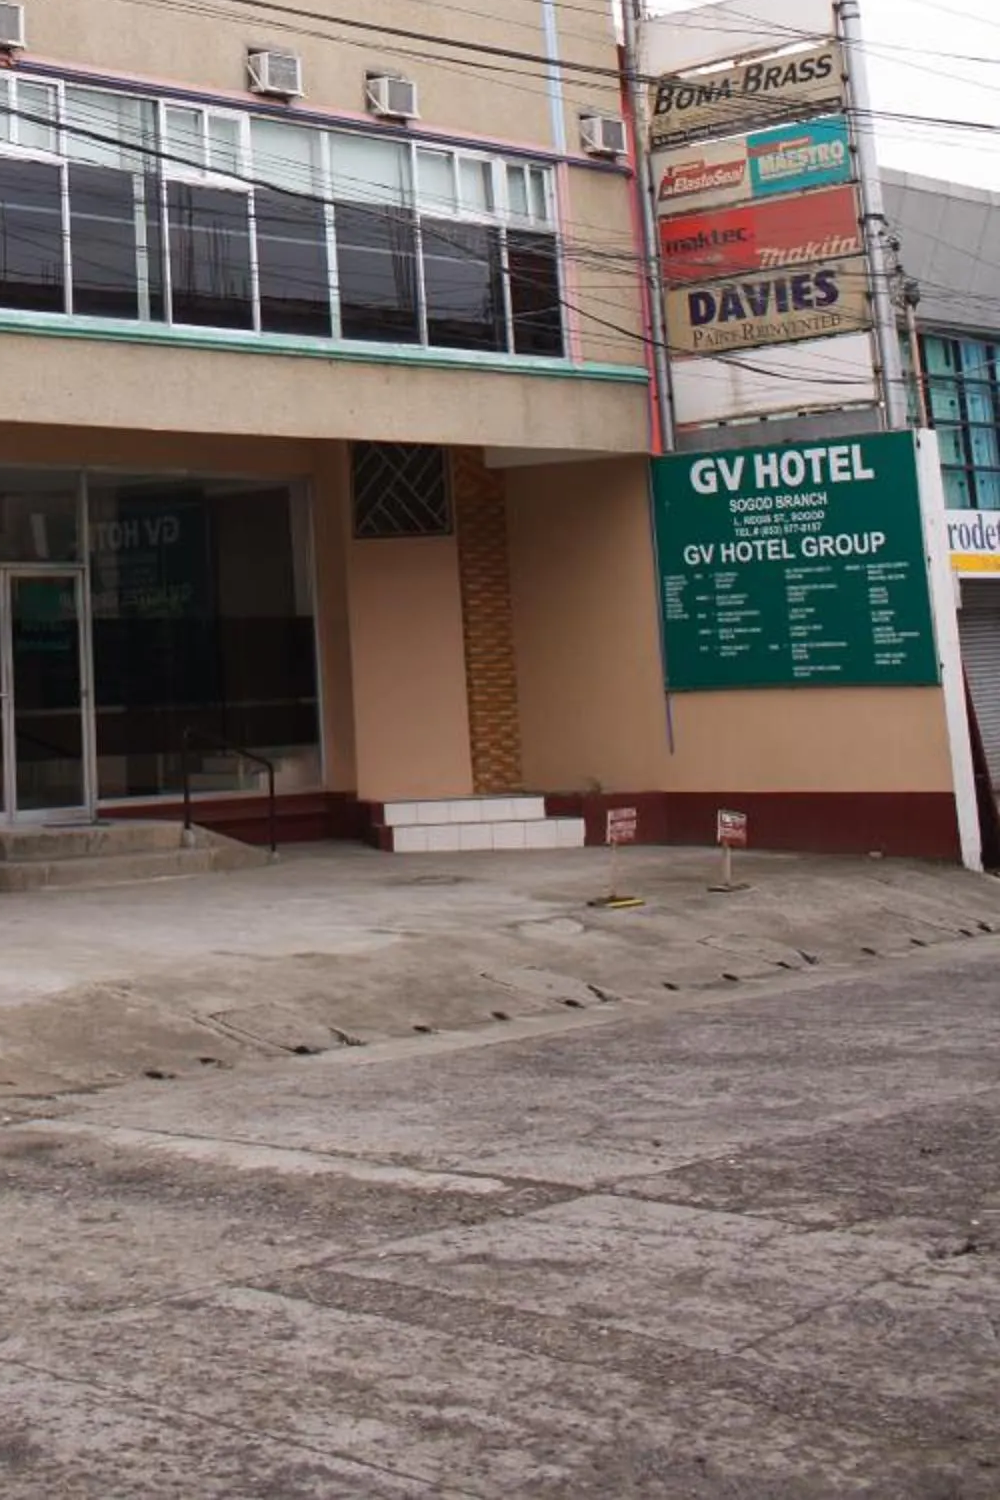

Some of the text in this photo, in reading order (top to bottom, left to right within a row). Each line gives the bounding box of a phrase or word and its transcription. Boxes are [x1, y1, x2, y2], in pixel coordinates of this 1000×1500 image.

[653, 54, 833, 116] BONA-BRASS
[688, 269, 839, 327] DAVIES
[690, 444, 875, 494] GV HOTEL
[729, 492, 828, 513] SOGOD BRANCH
[683, 531, 886, 566] GV HOTEL GROUP
